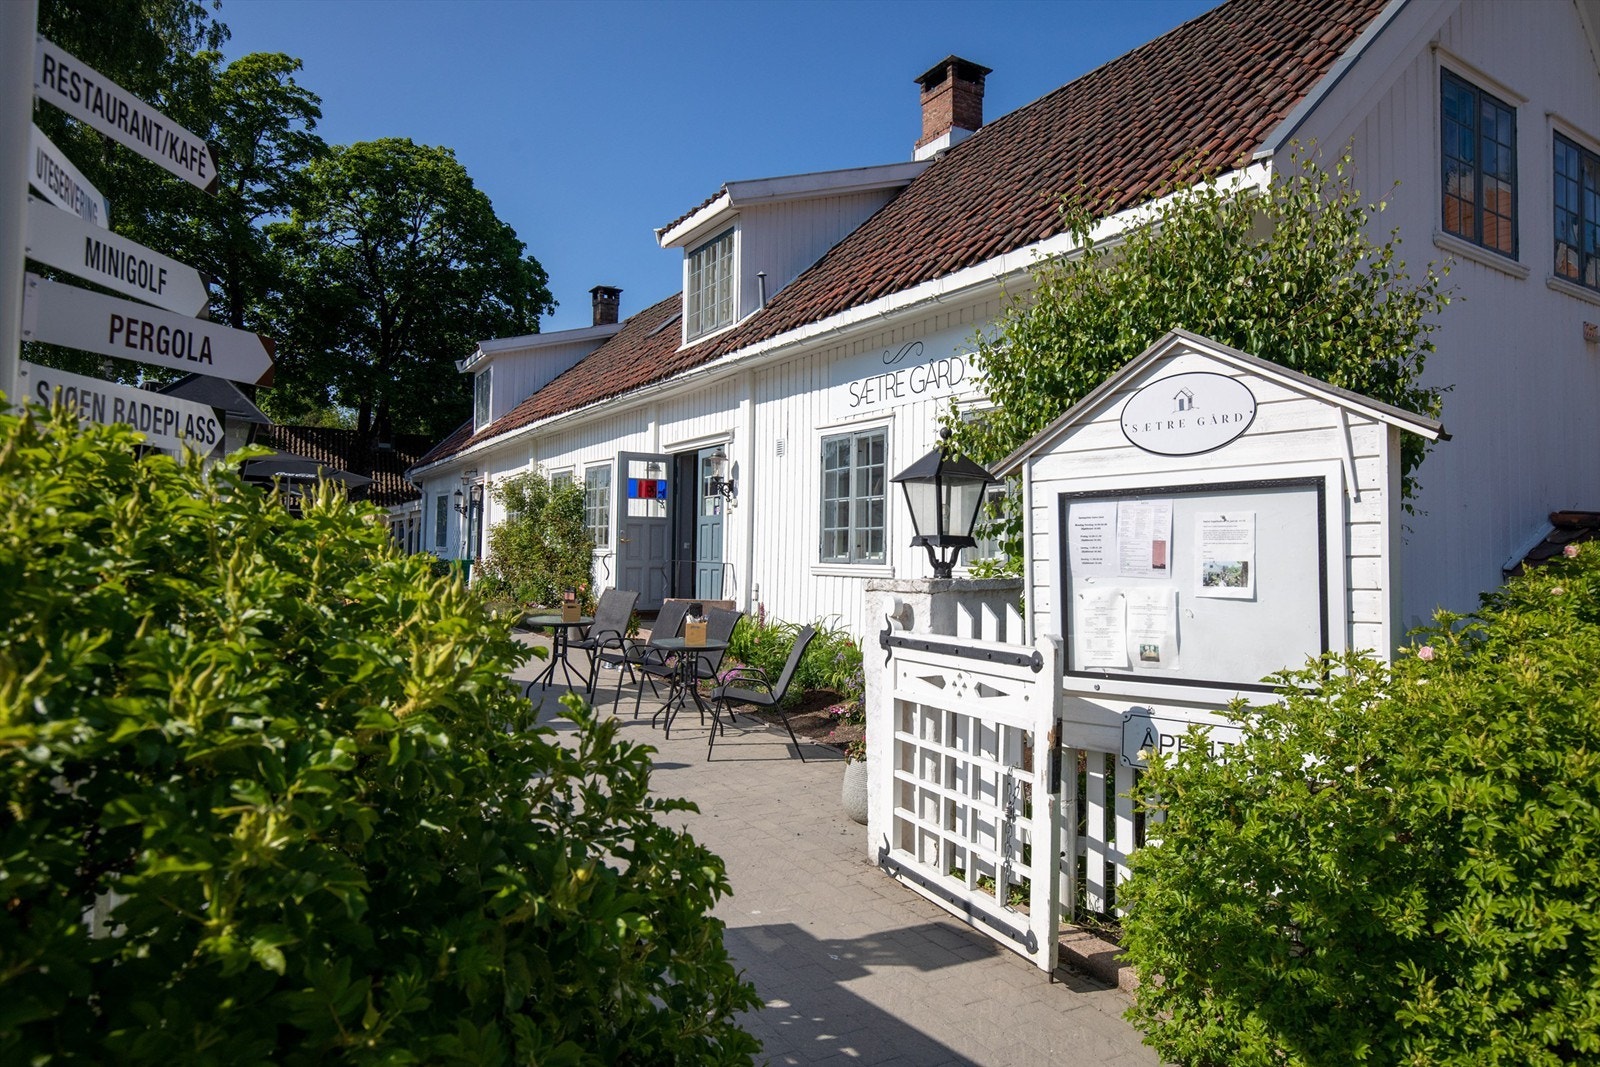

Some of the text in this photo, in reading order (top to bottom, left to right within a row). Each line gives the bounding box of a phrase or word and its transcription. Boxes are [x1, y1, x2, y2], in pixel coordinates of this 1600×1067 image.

[42, 53, 207, 179] RESTAURANT/KAFÉ
[36, 147, 98, 225] UTESERVERING
[85, 236, 168, 296] MINIGOLF
[109, 313, 213, 365] PERGOLA
[849, 358, 965, 408] SÆTRE GÅRD
[113, 397, 216, 445] BADEPLASS
[1132, 412, 1244, 433] SÆTRE GÅRD
